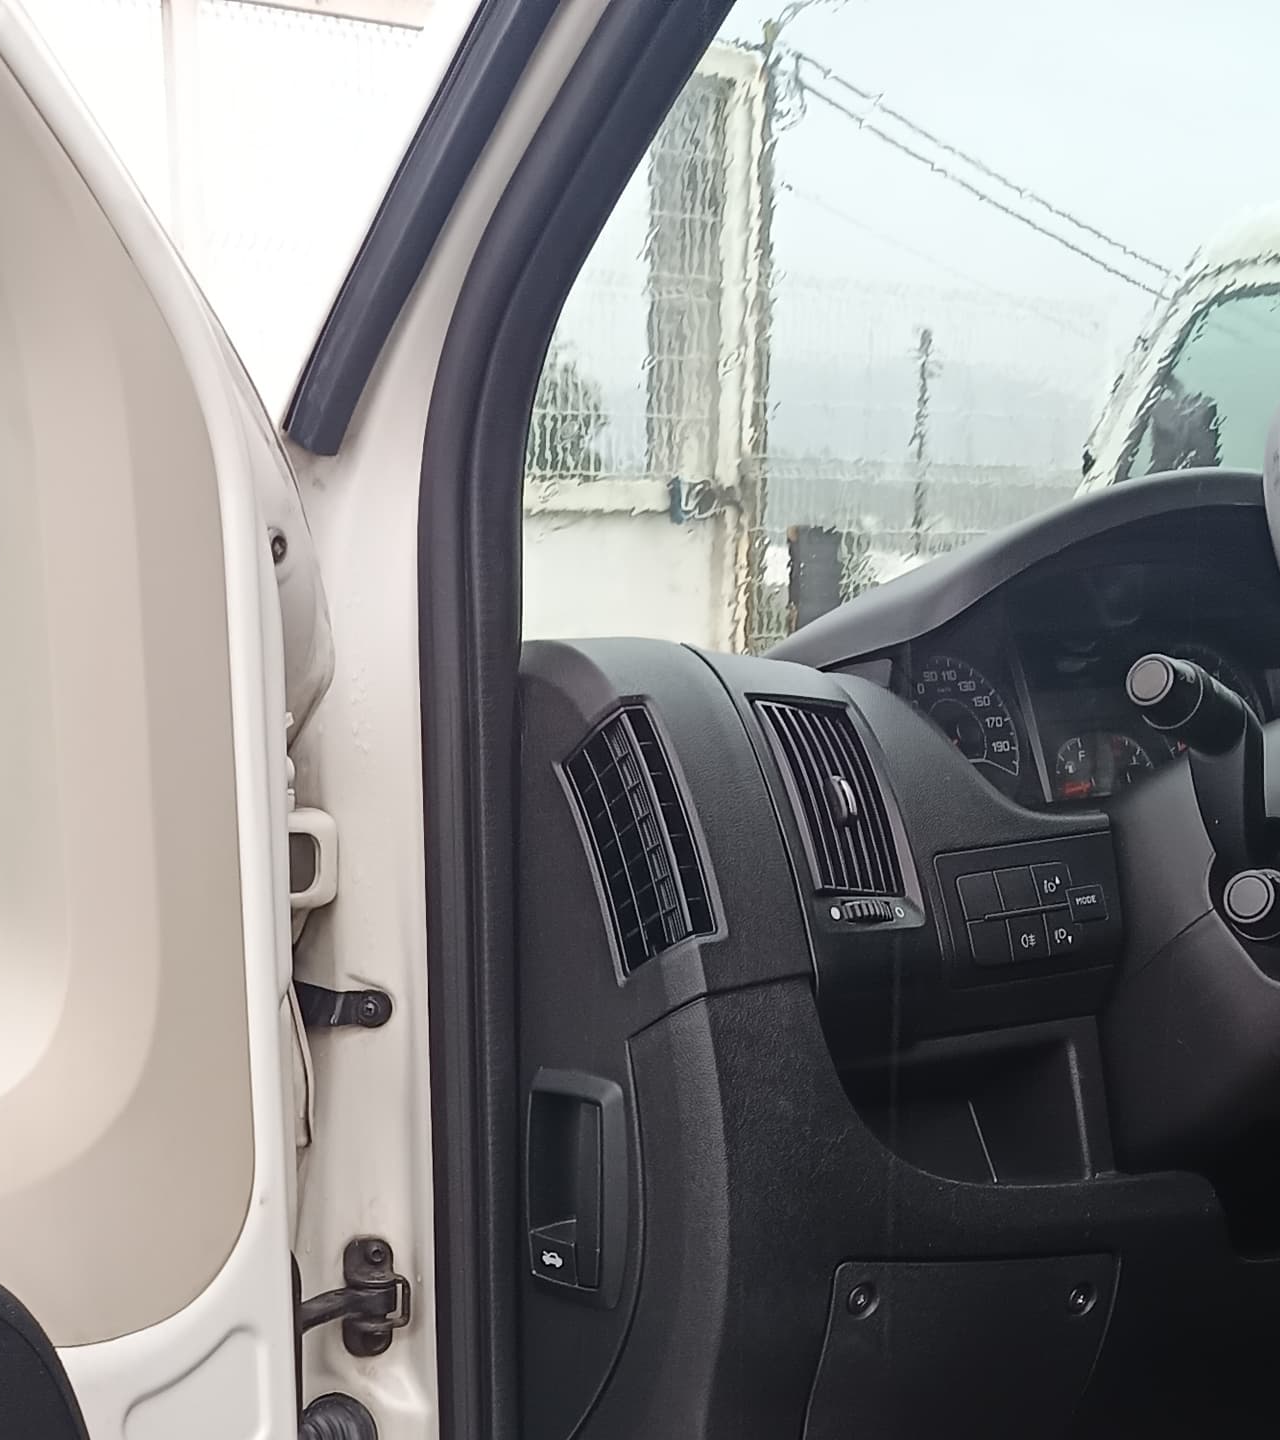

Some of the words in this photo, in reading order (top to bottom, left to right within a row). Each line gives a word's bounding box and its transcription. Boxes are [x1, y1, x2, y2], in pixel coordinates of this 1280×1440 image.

[942, 670, 957, 681] 110
[958, 681, 976, 692] 130
[972, 696, 991, 707] 150
[985, 716, 1003, 728] 170
[992, 740, 1010, 752] 190
[1078, 750, 1086, 762] F
[1075, 894, 1097, 905] MODE
